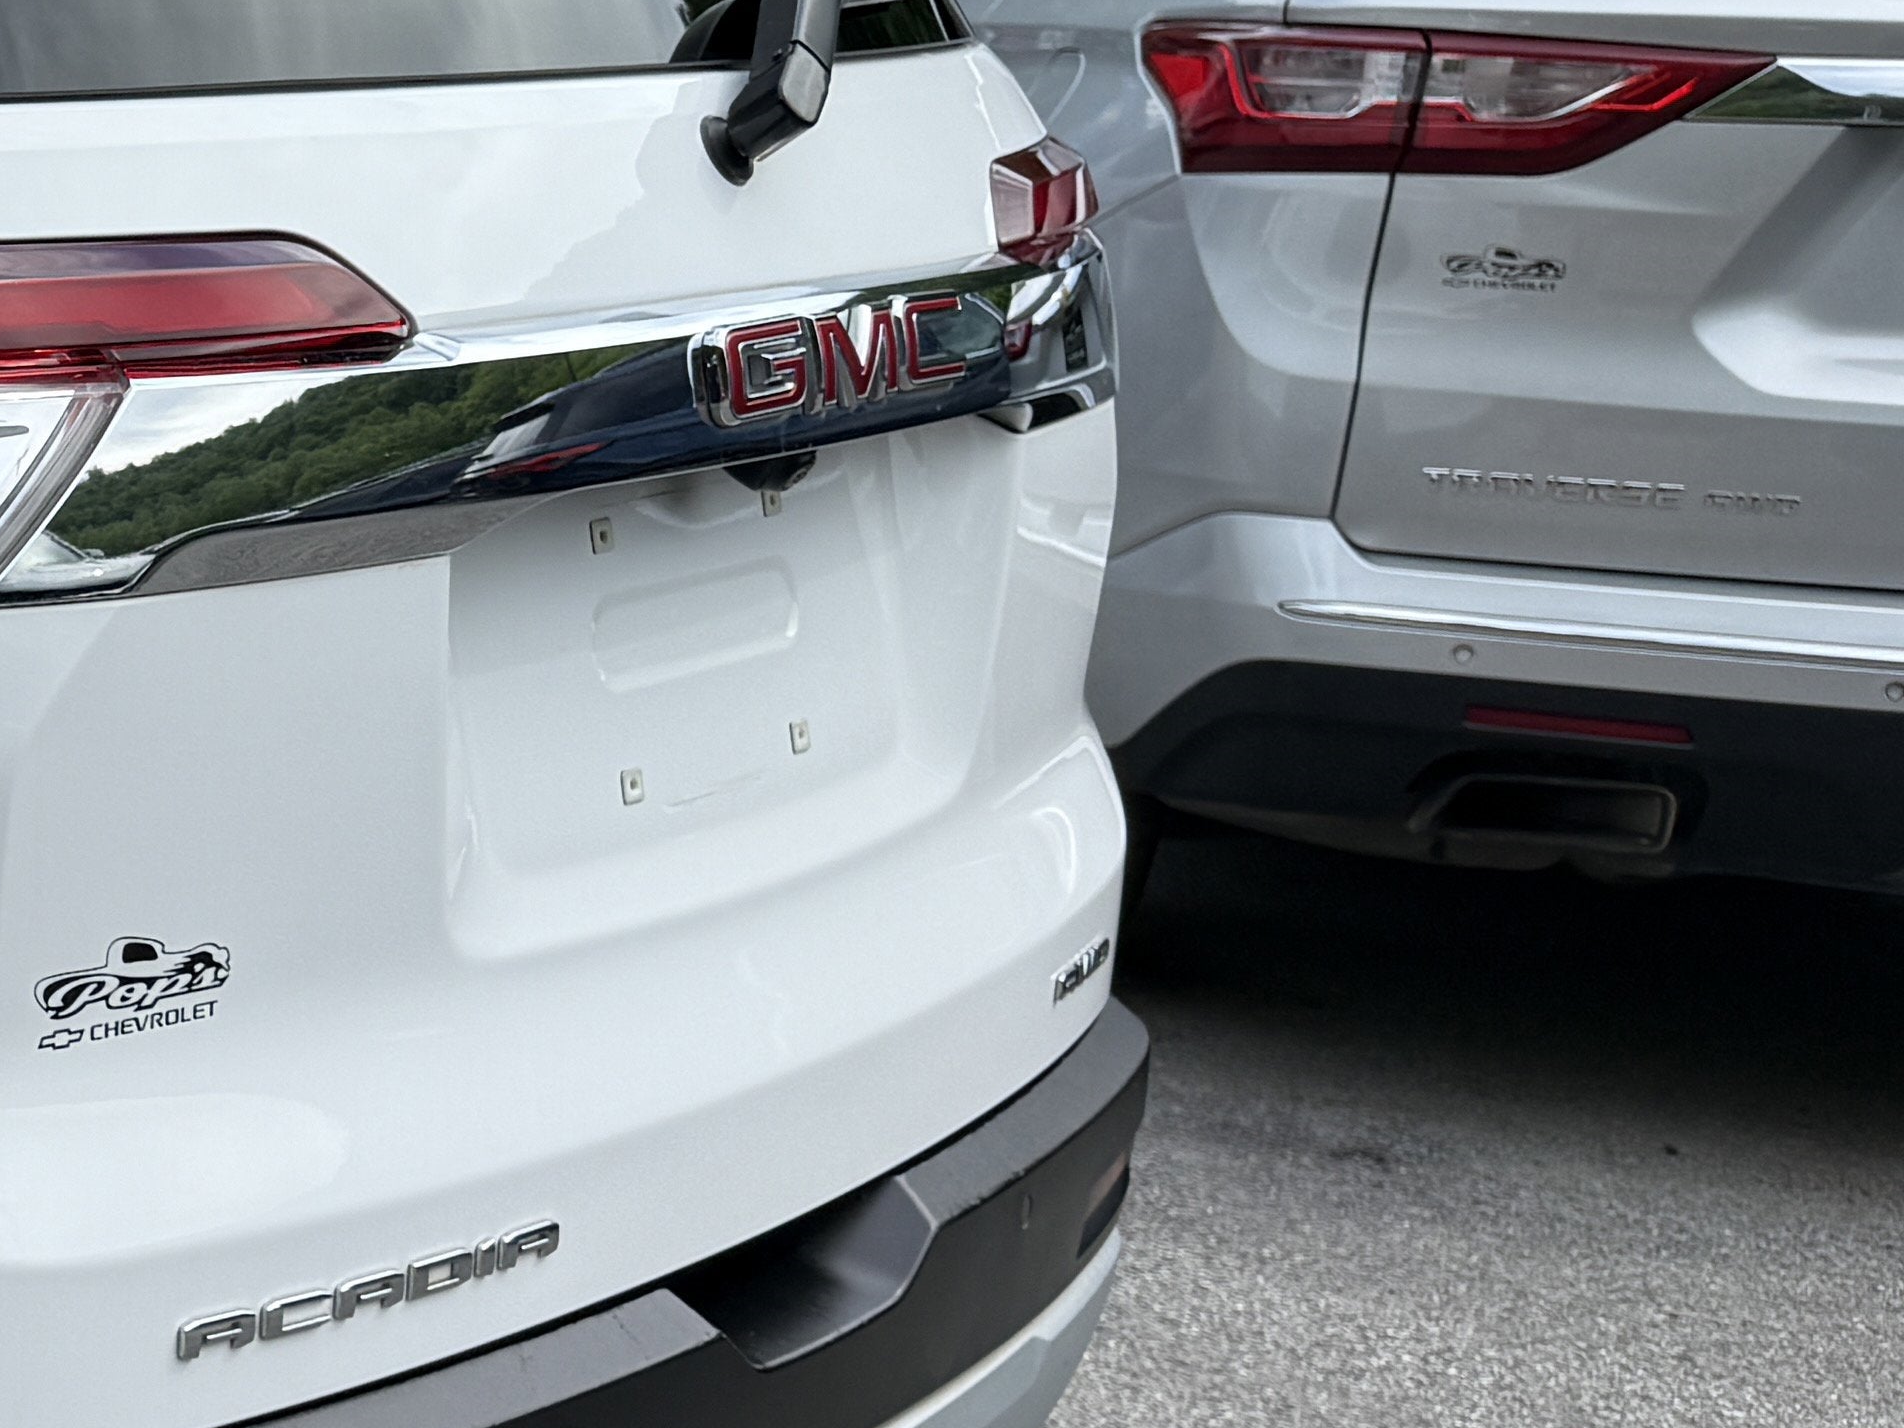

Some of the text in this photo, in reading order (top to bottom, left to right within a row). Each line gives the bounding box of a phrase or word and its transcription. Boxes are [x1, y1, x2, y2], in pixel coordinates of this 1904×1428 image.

[698, 290, 967, 425] GMC
[90, 1000, 218, 1041] CHEVROLET
[176, 1218, 560, 1360] ACADIA
